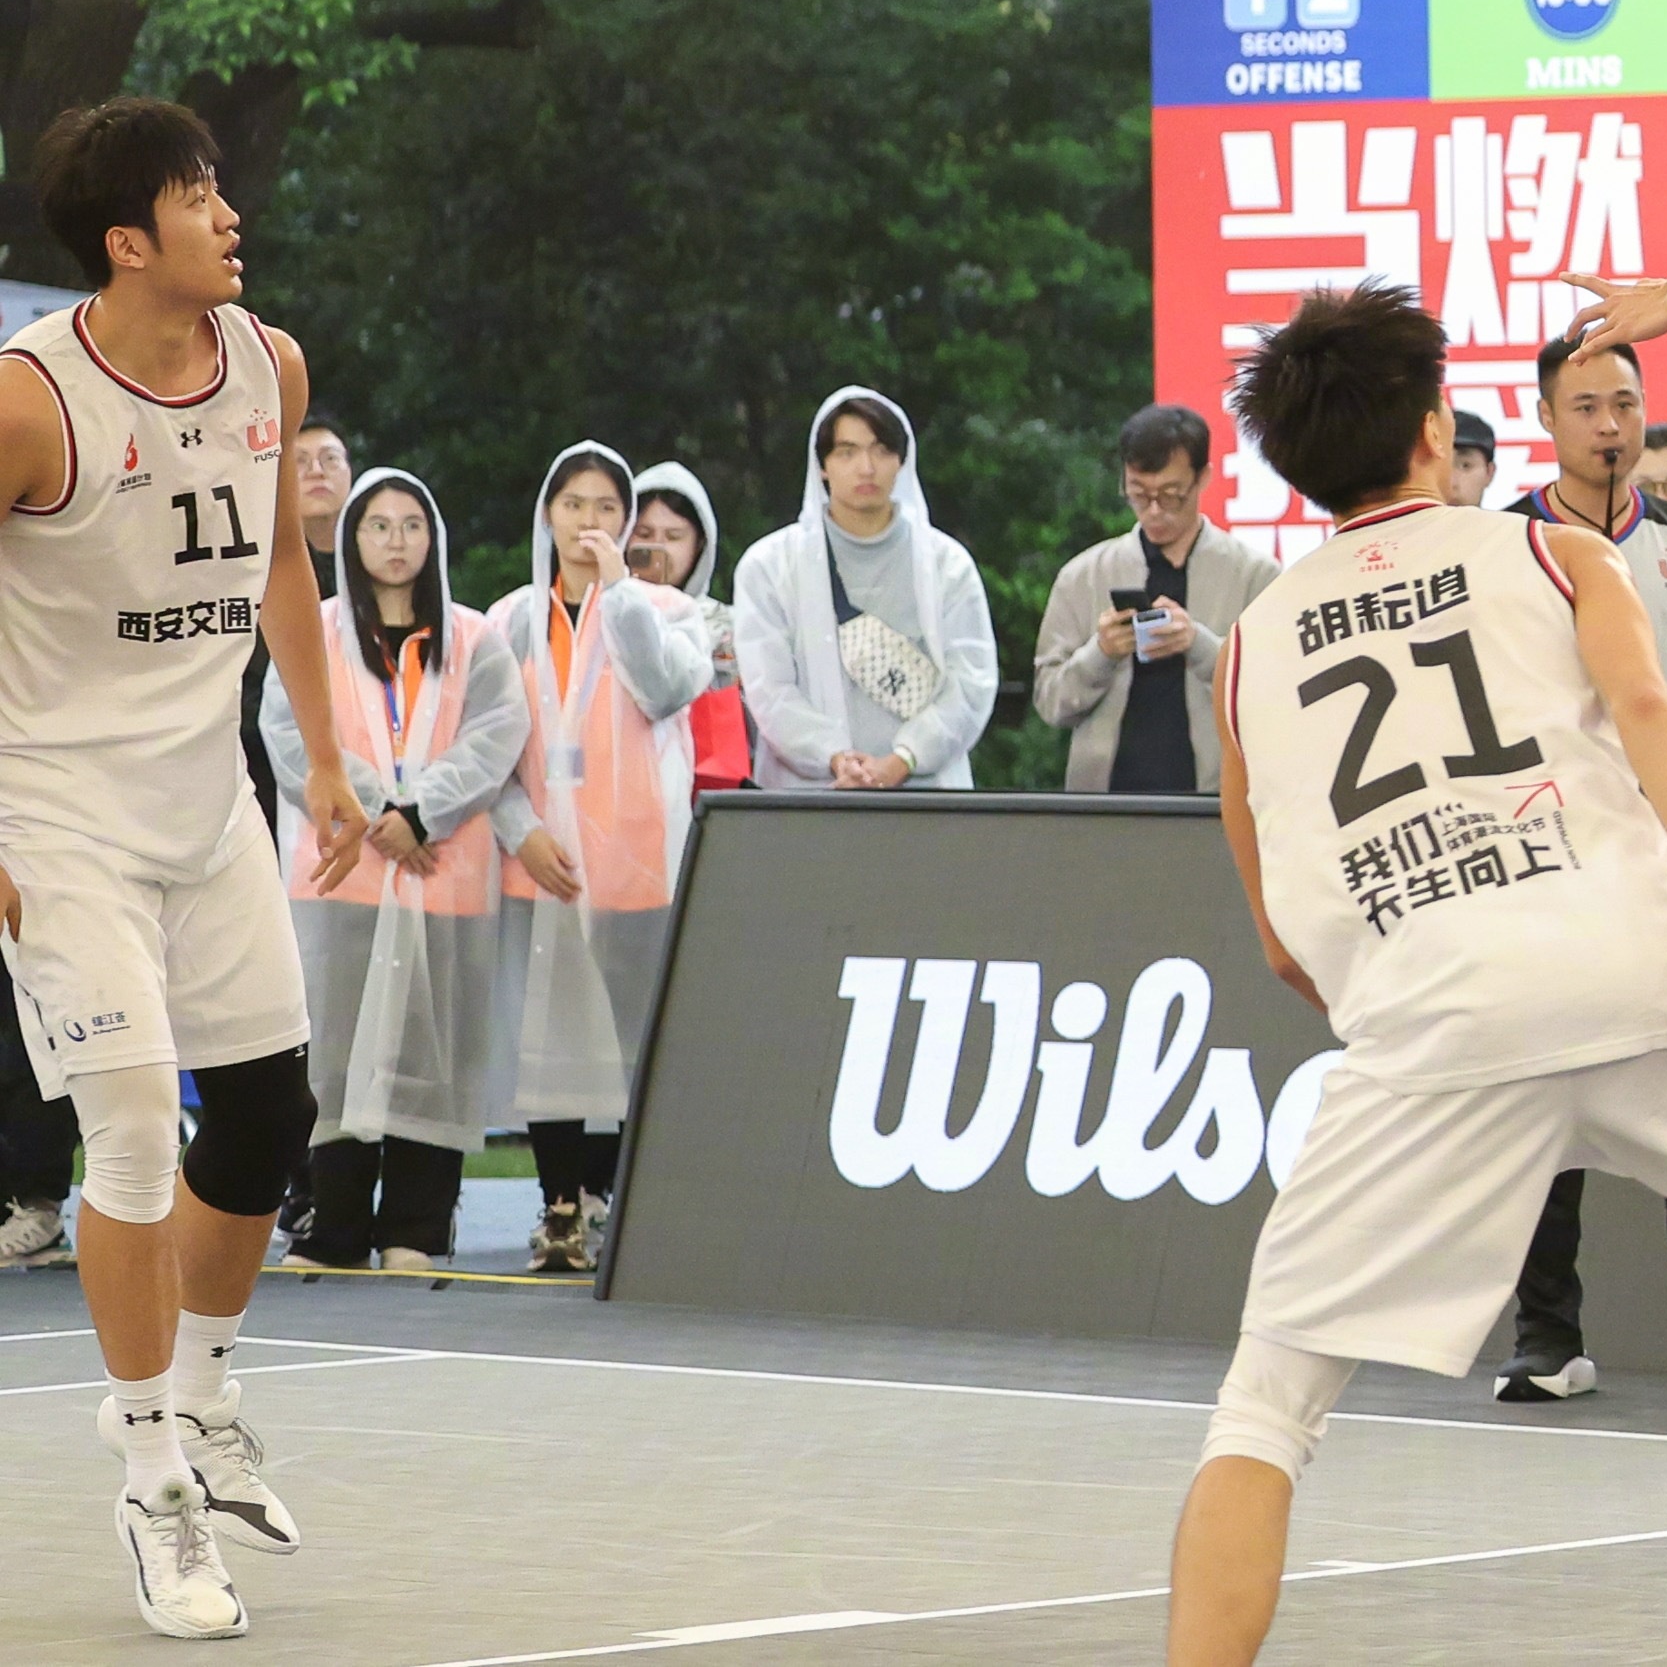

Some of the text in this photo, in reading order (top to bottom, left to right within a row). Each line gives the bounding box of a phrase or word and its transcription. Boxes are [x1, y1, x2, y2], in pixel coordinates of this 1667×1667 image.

[1241, 29, 1346, 56] SECONDS
[1526, 56, 1623, 89] MINS
[1226, 60, 1362, 94] OFFENSE
[171, 484, 260, 566] 11
[117, 596, 261, 643] 西安交通
[1296, 628, 1545, 829] 21
[1340, 811, 1444, 893] 我们
[1356, 838, 1563, 938] 天生向上
